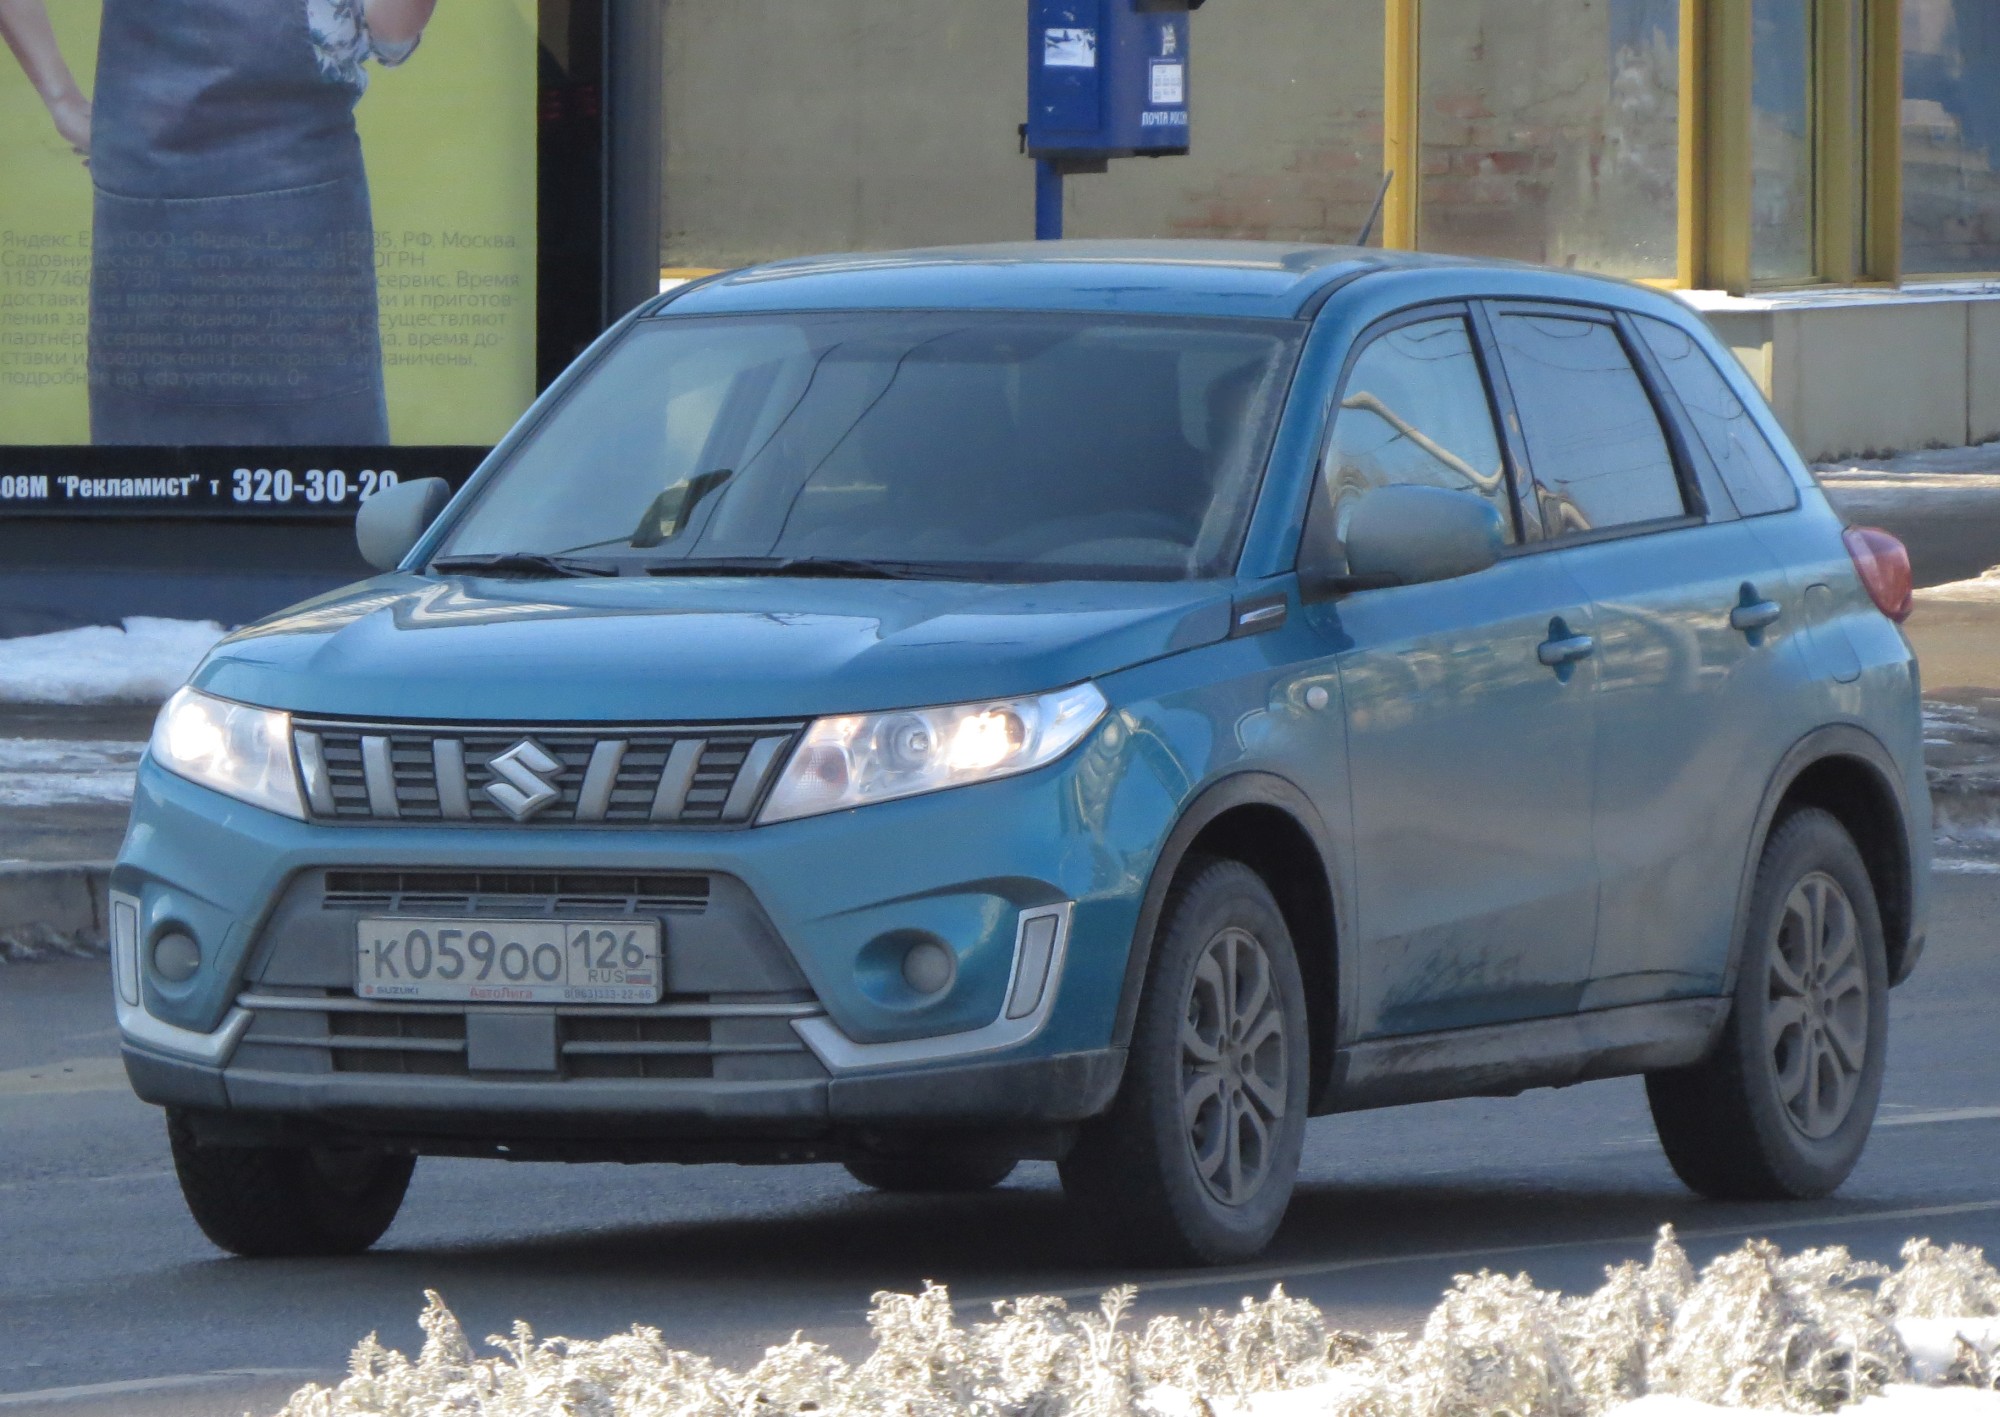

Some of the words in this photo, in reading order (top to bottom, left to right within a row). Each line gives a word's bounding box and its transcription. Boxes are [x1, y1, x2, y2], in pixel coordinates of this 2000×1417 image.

[1142, 111, 1168, 126] ПОЧТА
[456, 271, 520, 290] Время
[291, 292, 398, 311] обрабоки
[1, 314, 60, 326] ления
[65, 314, 130, 327] зааза
[408, 333, 468, 349] время
[0, 475, 48, 498] 08М
[232, 468, 399, 502] 320-30-20
[570, 929, 644, 969] 126
[587, 968, 625, 983] RUS
[376, 986, 419, 995] SUZUKI
